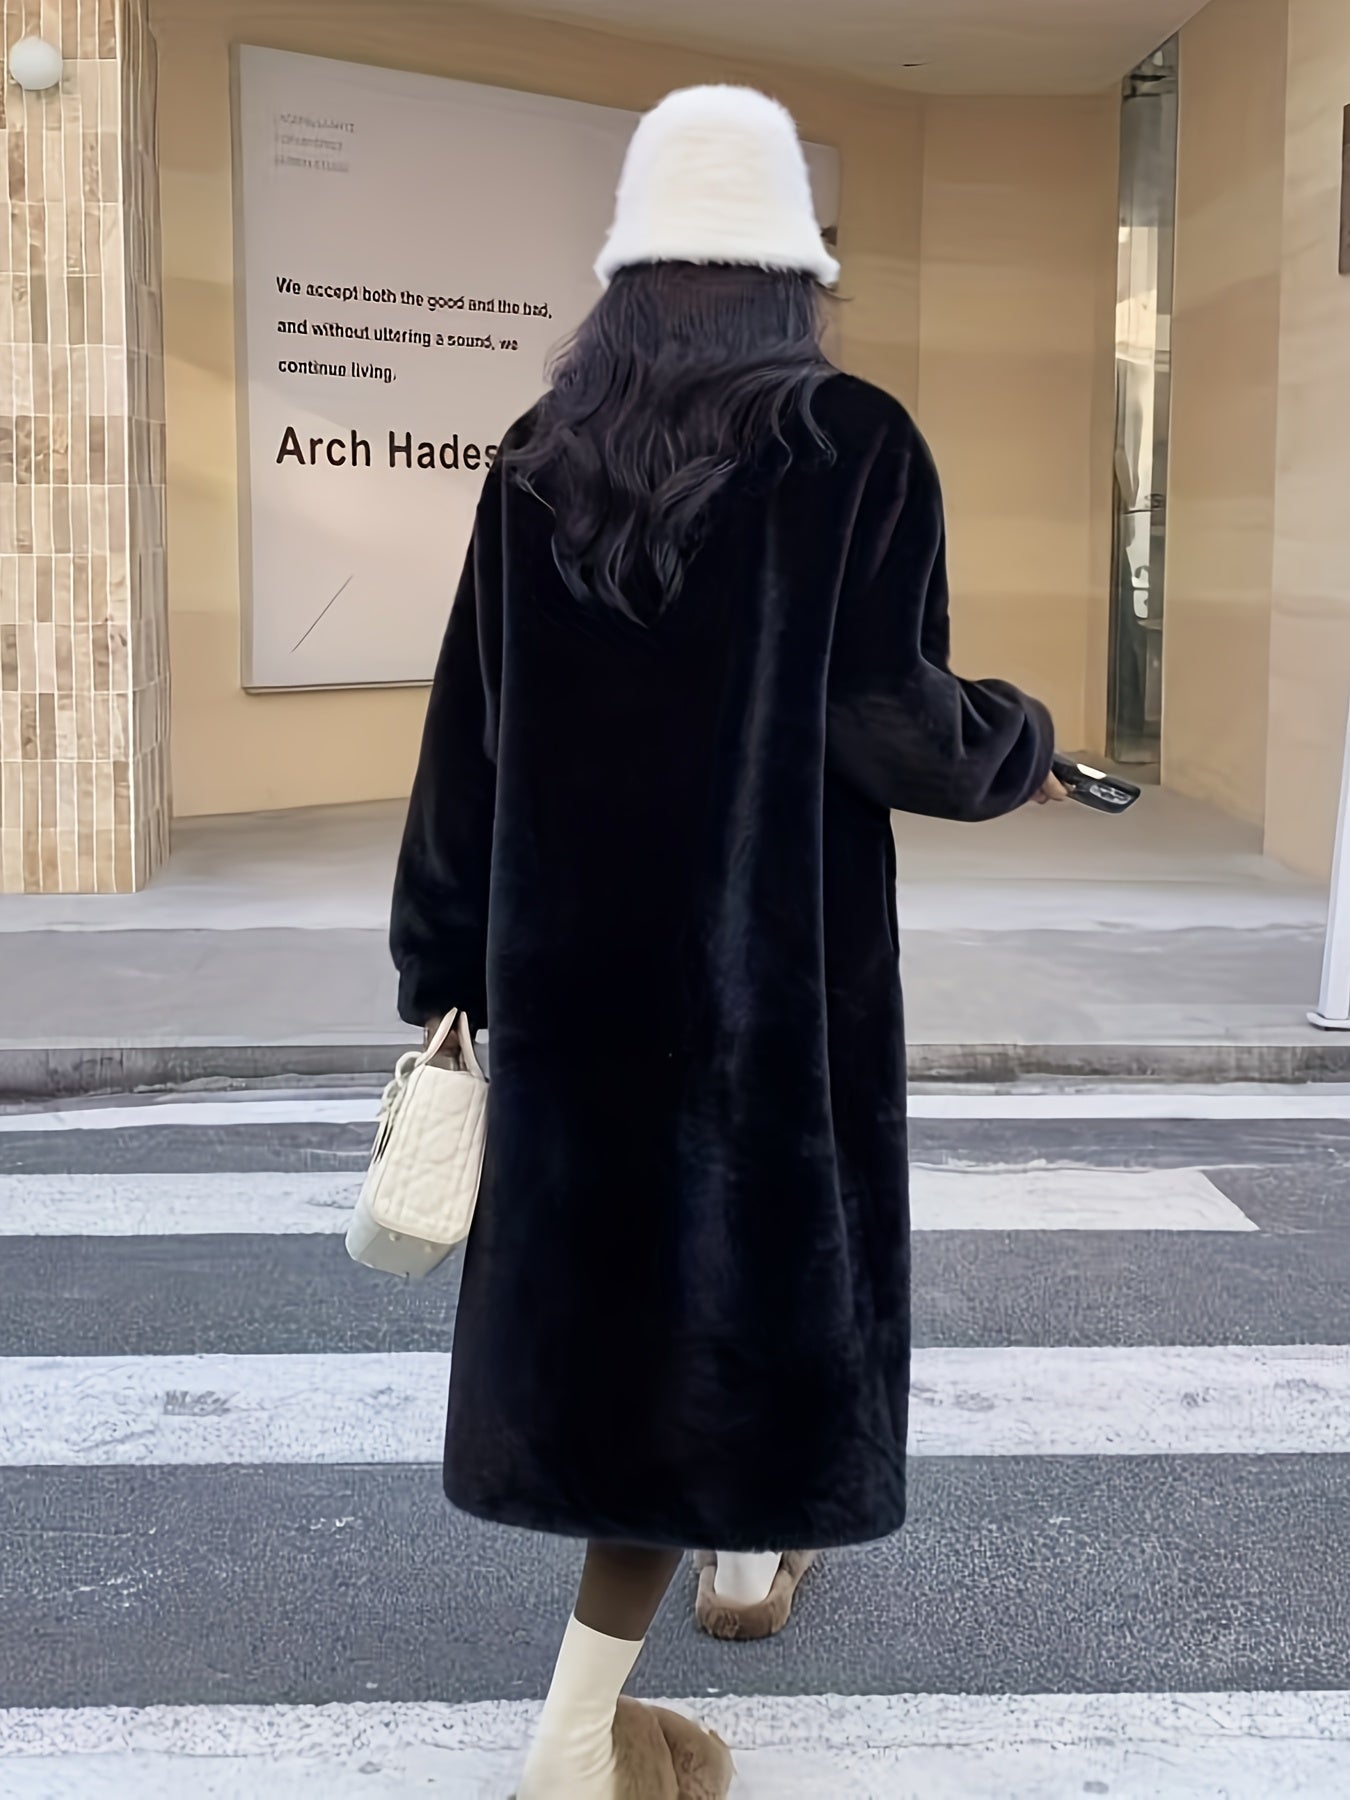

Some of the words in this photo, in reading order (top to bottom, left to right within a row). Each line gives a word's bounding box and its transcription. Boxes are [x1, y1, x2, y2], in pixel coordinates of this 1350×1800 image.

[276, 276, 301, 295] We
[306, 283, 359, 302] accept
[363, 286, 396, 304] both
[401, 290, 423, 307] the
[428, 295, 464, 312] good
[468, 298, 495, 312] and
[277, 319, 307, 335] and
[312, 322, 370, 341] without
[374, 327, 431, 347] uttering
[436, 333, 444, 346] a
[278, 358, 346, 378] continue
[276, 426, 371, 467] Arch
